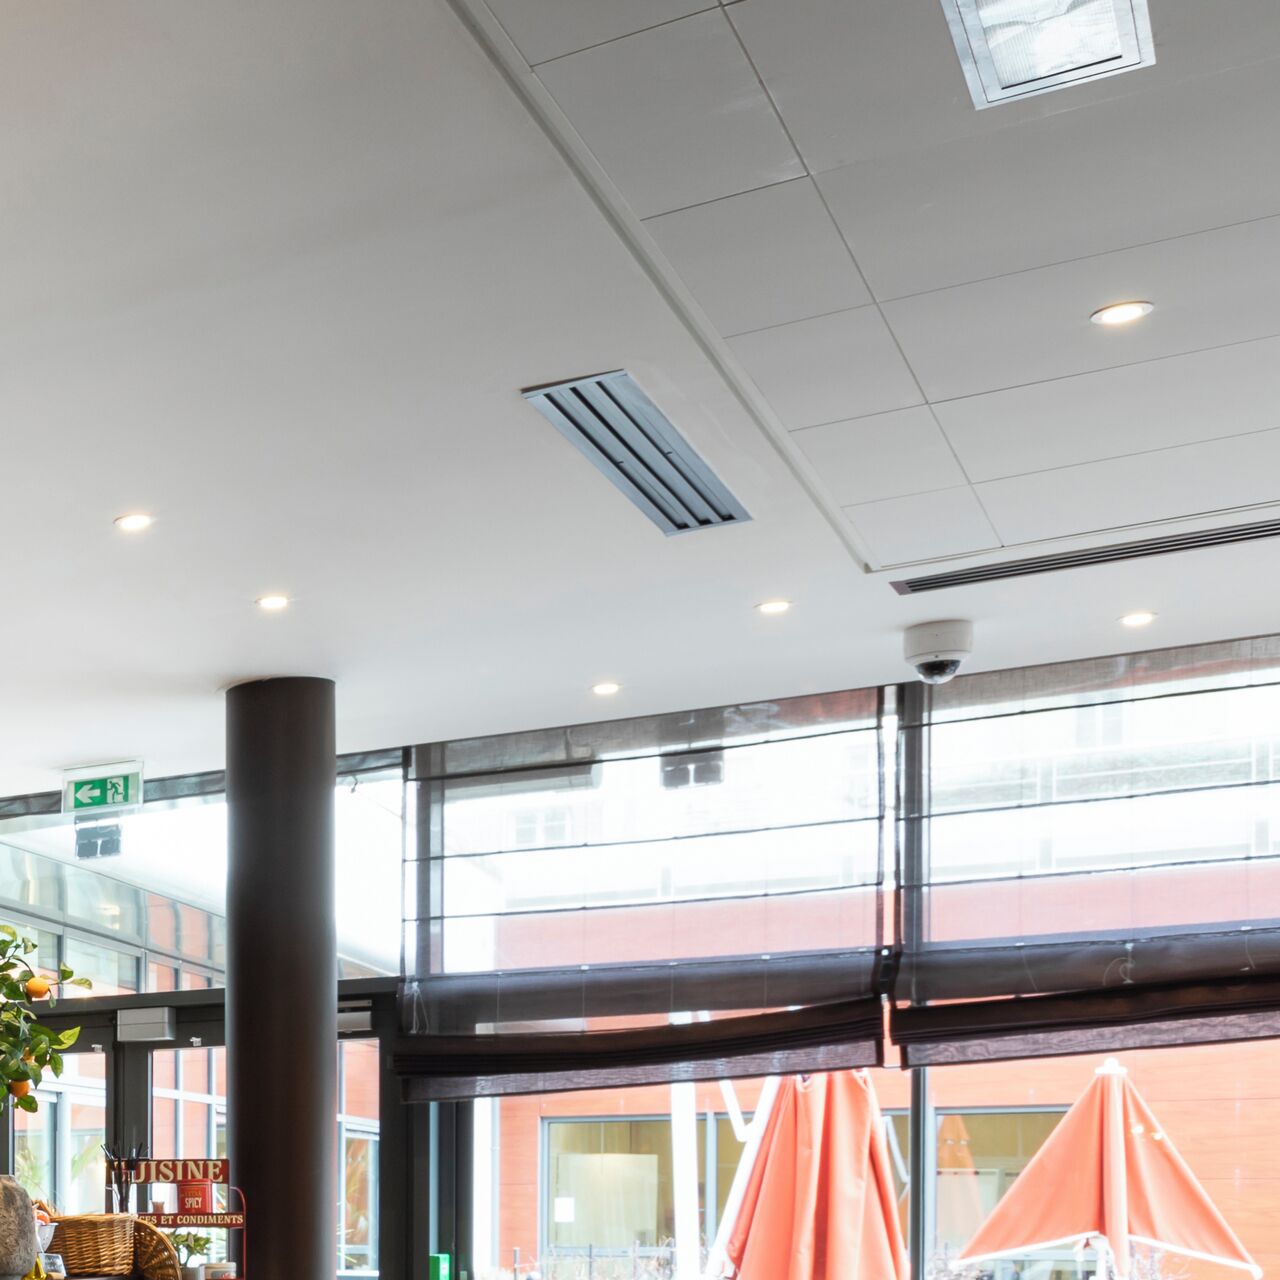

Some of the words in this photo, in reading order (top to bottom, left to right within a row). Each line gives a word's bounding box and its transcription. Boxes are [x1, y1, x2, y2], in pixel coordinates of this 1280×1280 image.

[113, 1160, 223, 1183] UISINE
[185, 1197, 202, 1208] SPICY
[160, 1215, 174, 1225] ET
[177, 1214, 243, 1225] CONDIMENTS
